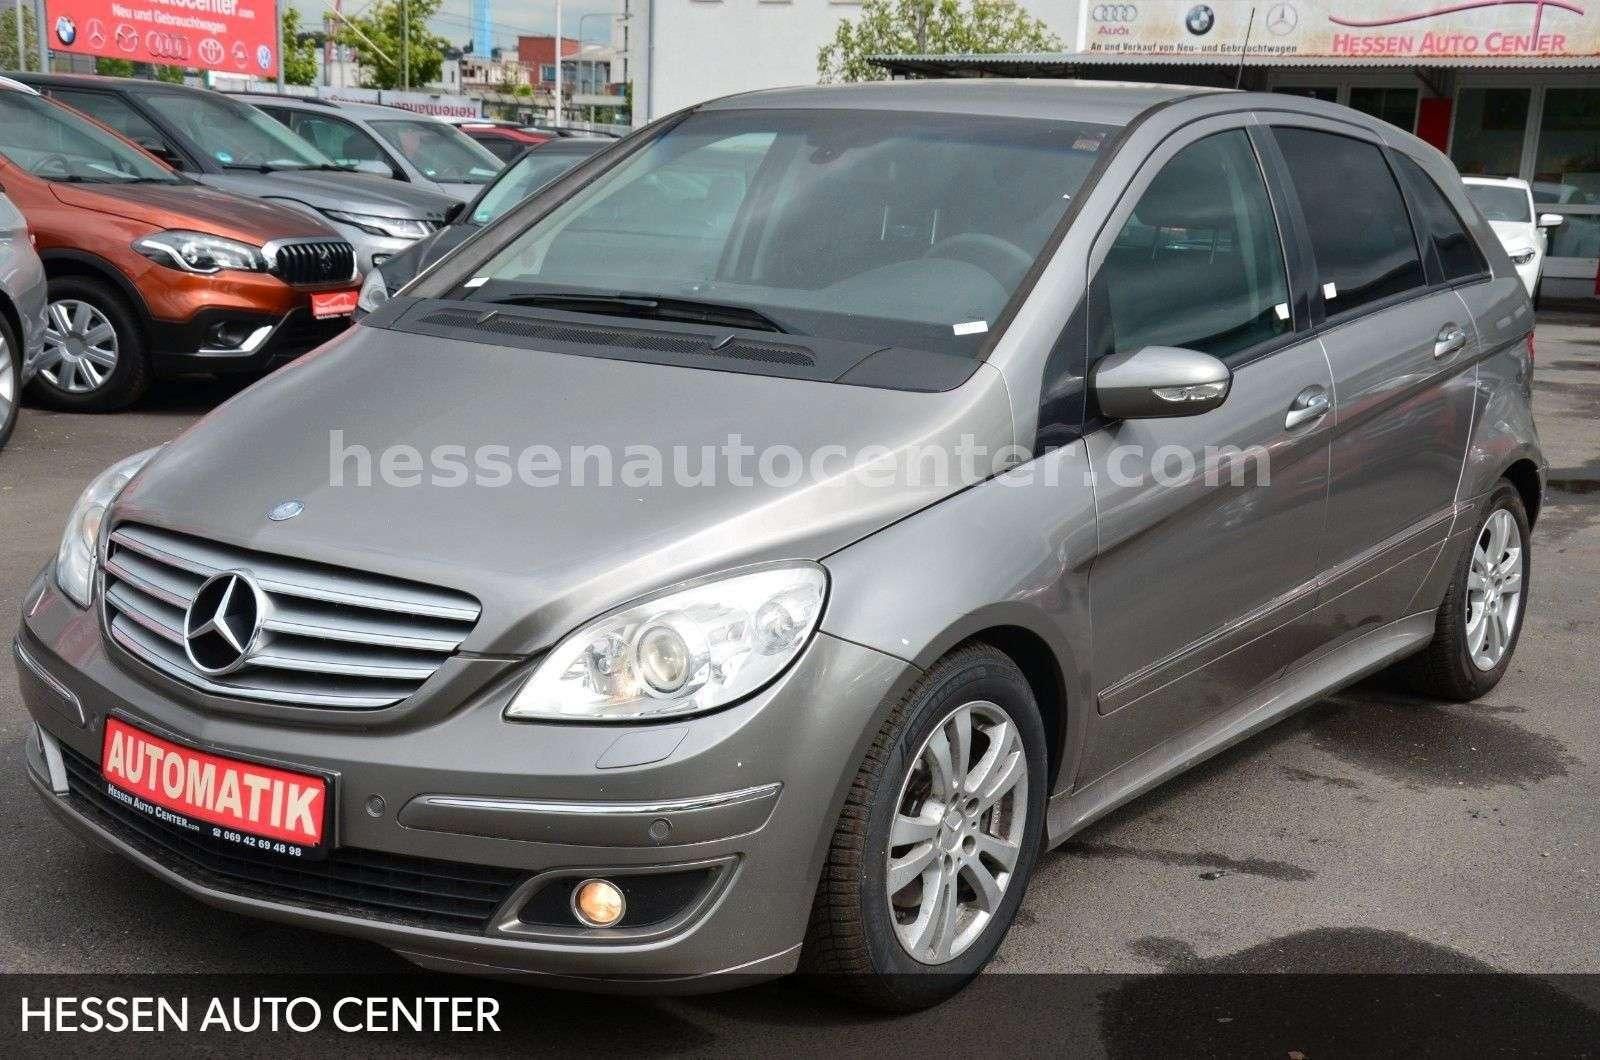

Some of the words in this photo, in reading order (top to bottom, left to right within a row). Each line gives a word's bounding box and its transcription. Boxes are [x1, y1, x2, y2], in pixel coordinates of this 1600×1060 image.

[1098, 25, 1130, 35] Audi
[1333, 34, 1413, 52] HESSEN
[1420, 32, 1478, 53] AUTO
[106, 729, 319, 837] AUTOMATIK
[107, 783, 133, 805] HESSEN
[133, 797, 154, 815] AUTO
[243, 835, 256, 847] 42
[258, 839, 271, 850] 69
[273, 842, 286, 854] 48
[288, 846, 302, 857] 98
